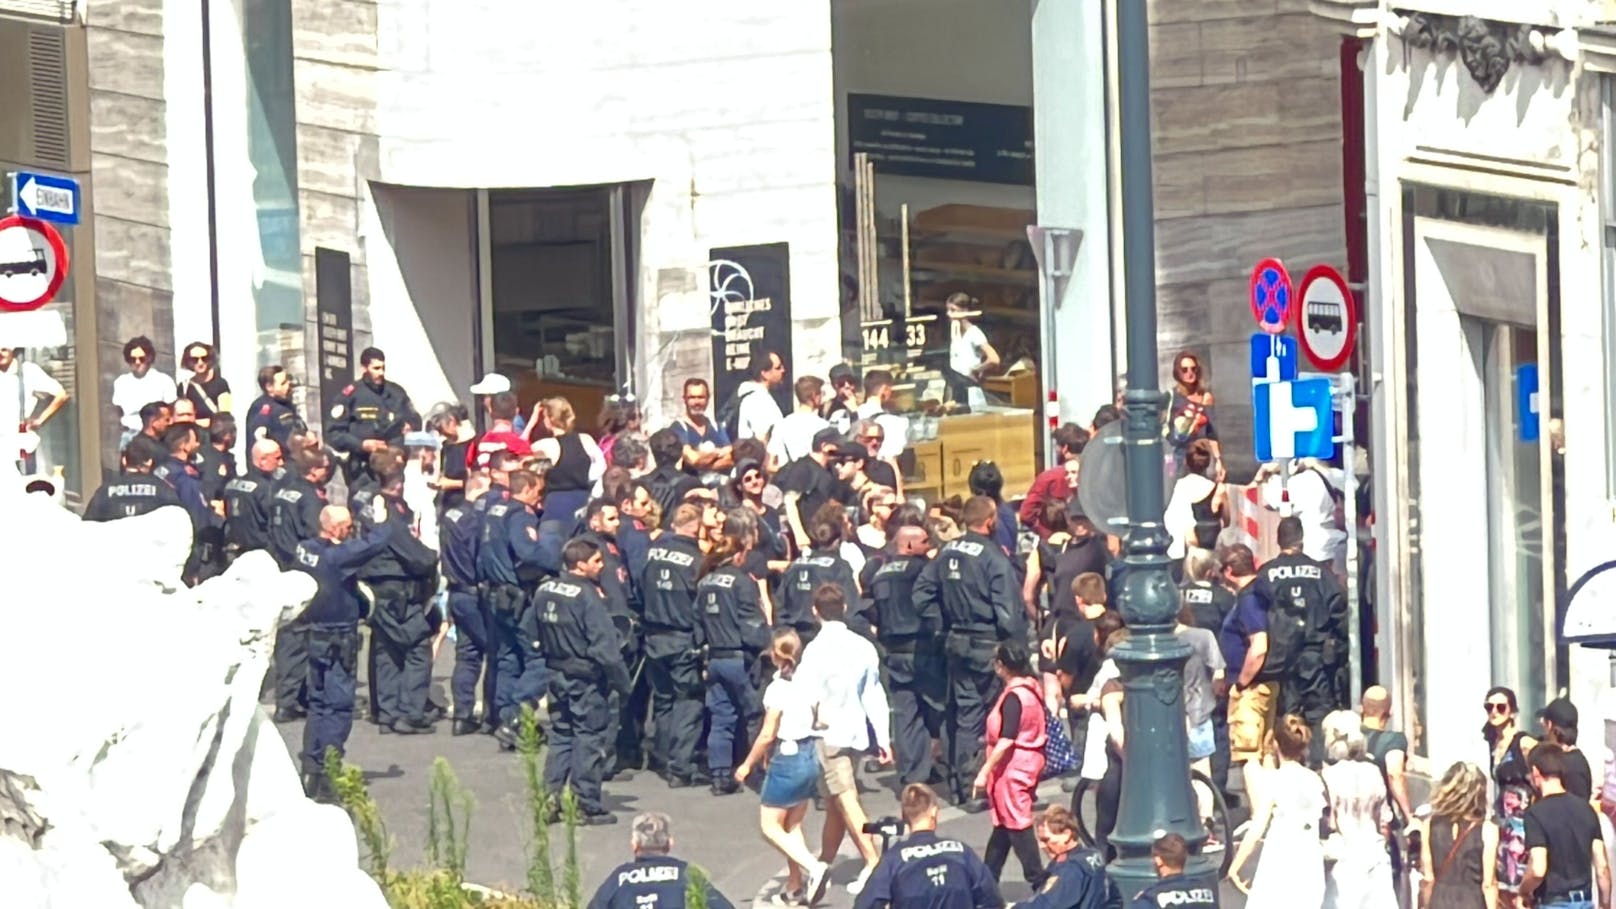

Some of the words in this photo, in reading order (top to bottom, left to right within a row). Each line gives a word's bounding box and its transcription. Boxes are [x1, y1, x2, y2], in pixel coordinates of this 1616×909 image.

[862, 327, 889, 351] 144
[906, 323, 926, 347] 33
[108, 484, 156, 498] POLIZEI
[125, 505, 136, 515] U
[648, 548, 694, 566] POLIZEI
[949, 558, 959, 570] U
[660, 569, 670, 580] U
[799, 570, 809, 582] U
[1268, 565, 1321, 583] POLIZEI
[707, 592, 717, 604] U
[1291, 586, 1301, 597] U
[901, 840, 964, 862] POLIZEI
[618, 866, 679, 887] POLIZEI
[1157, 888, 1214, 909] POLIZEI
